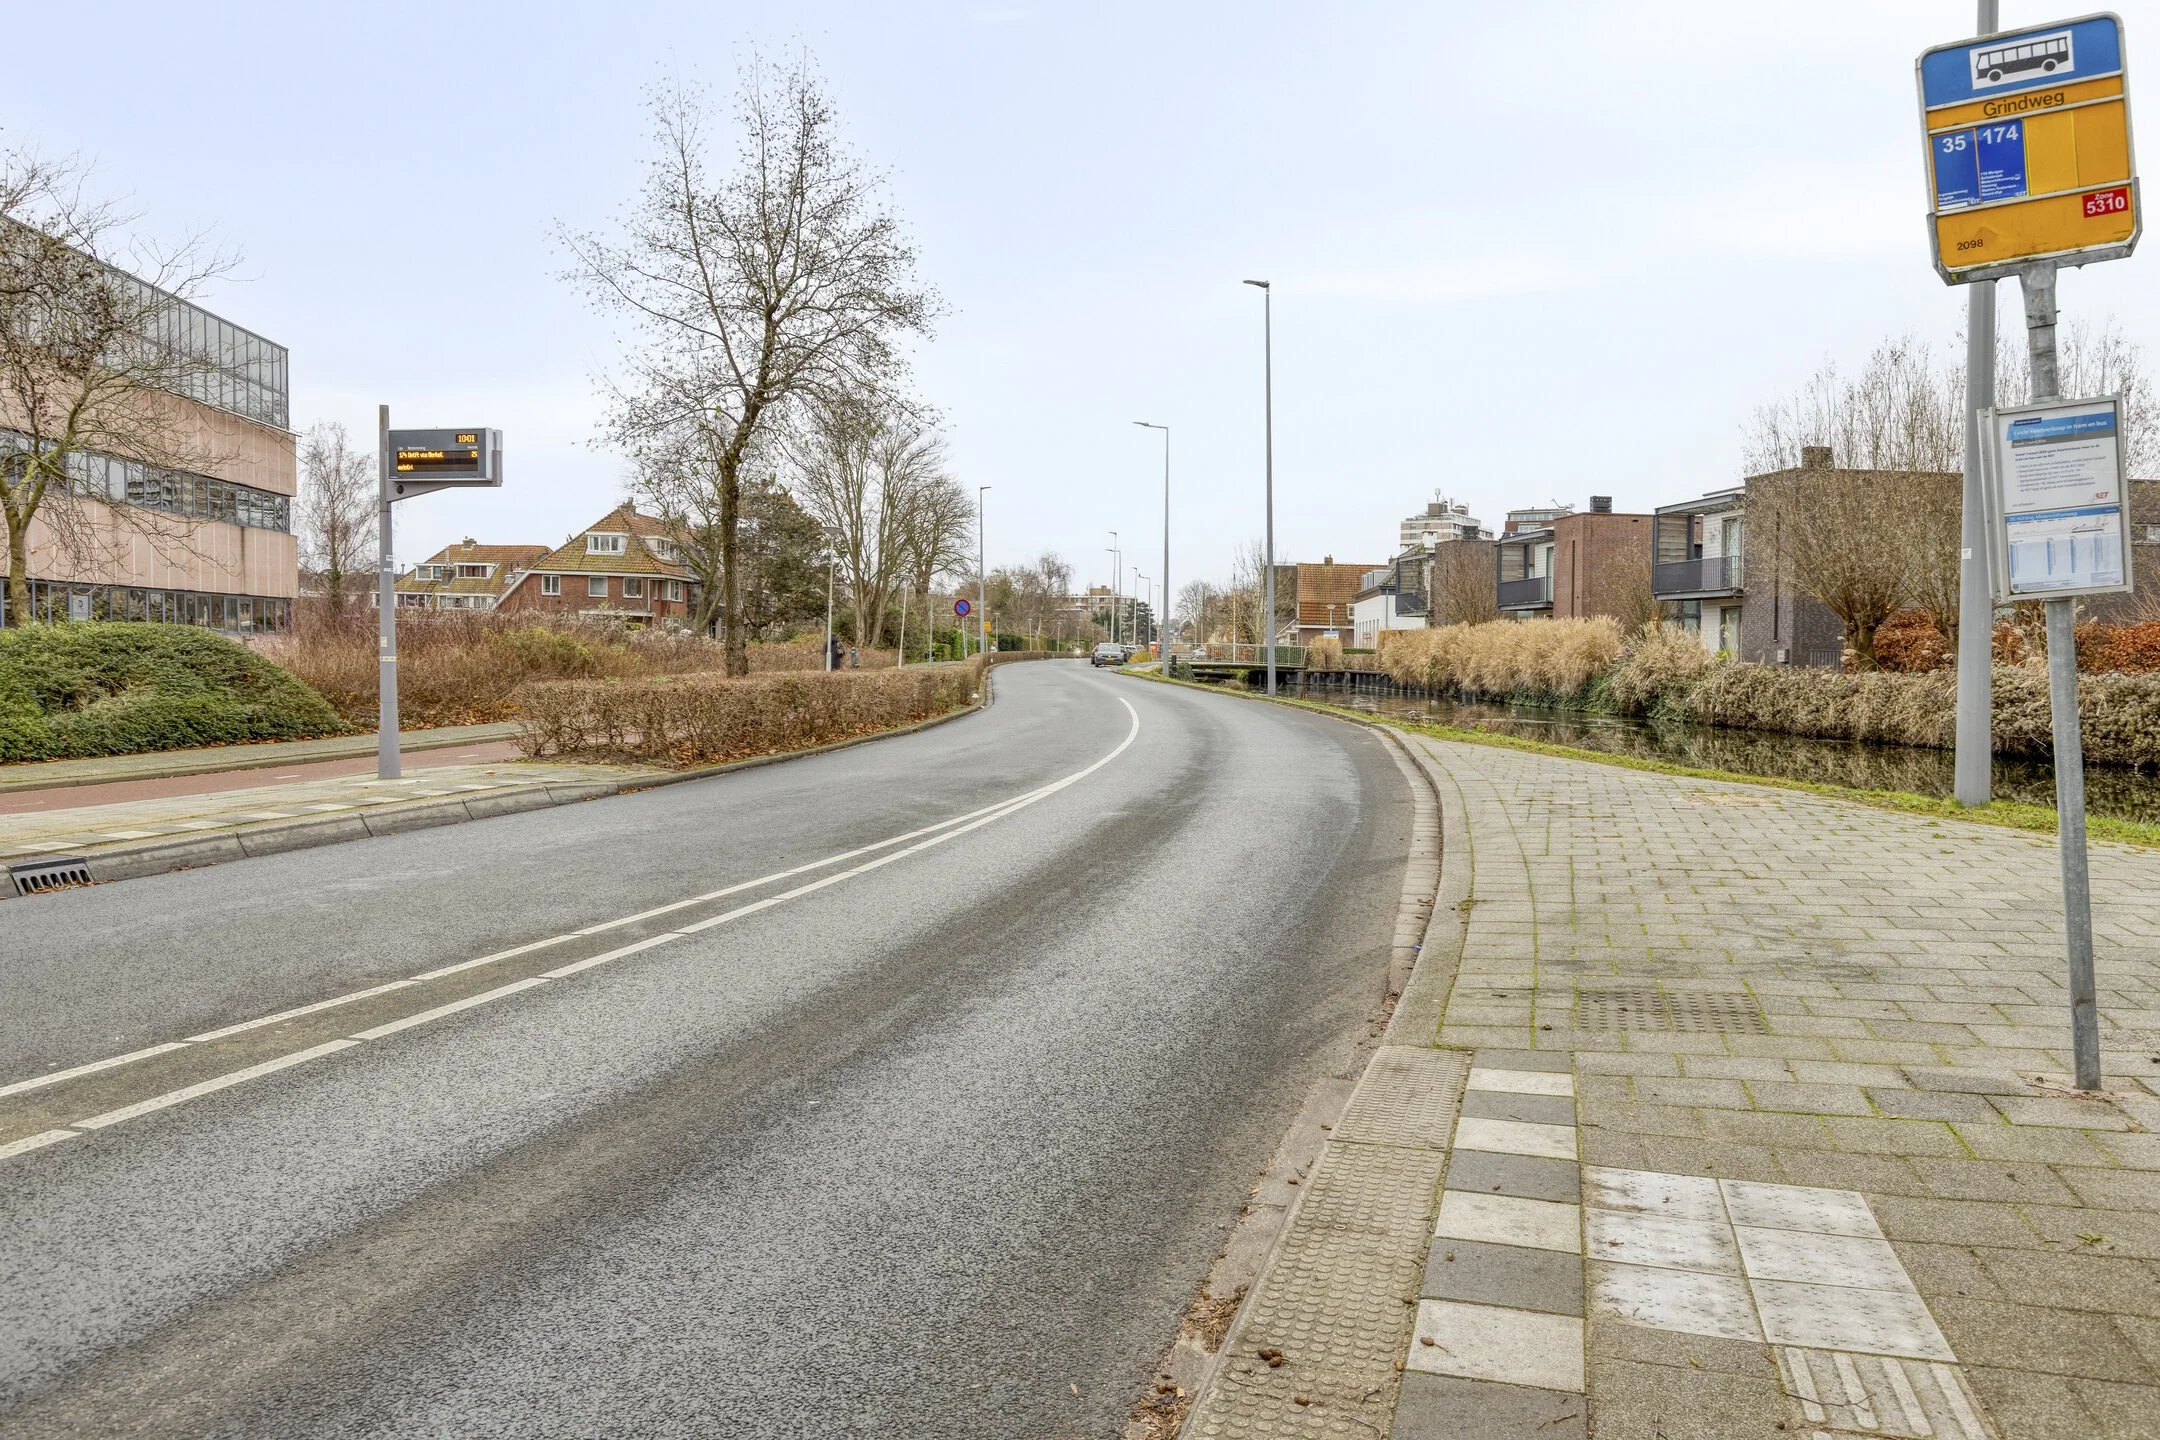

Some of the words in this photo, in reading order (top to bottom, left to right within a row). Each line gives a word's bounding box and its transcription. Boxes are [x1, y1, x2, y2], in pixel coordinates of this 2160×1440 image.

[1984, 91, 2064, 117] Grindweg
[1942, 135, 1967, 153] 35
[1982, 125, 2018, 145] 174
[2086, 196, 2125, 214] 5310
[2095, 192, 2114, 200] Zone
[1957, 239, 1984, 251] 2098
[458, 434, 475, 442] 10:01
